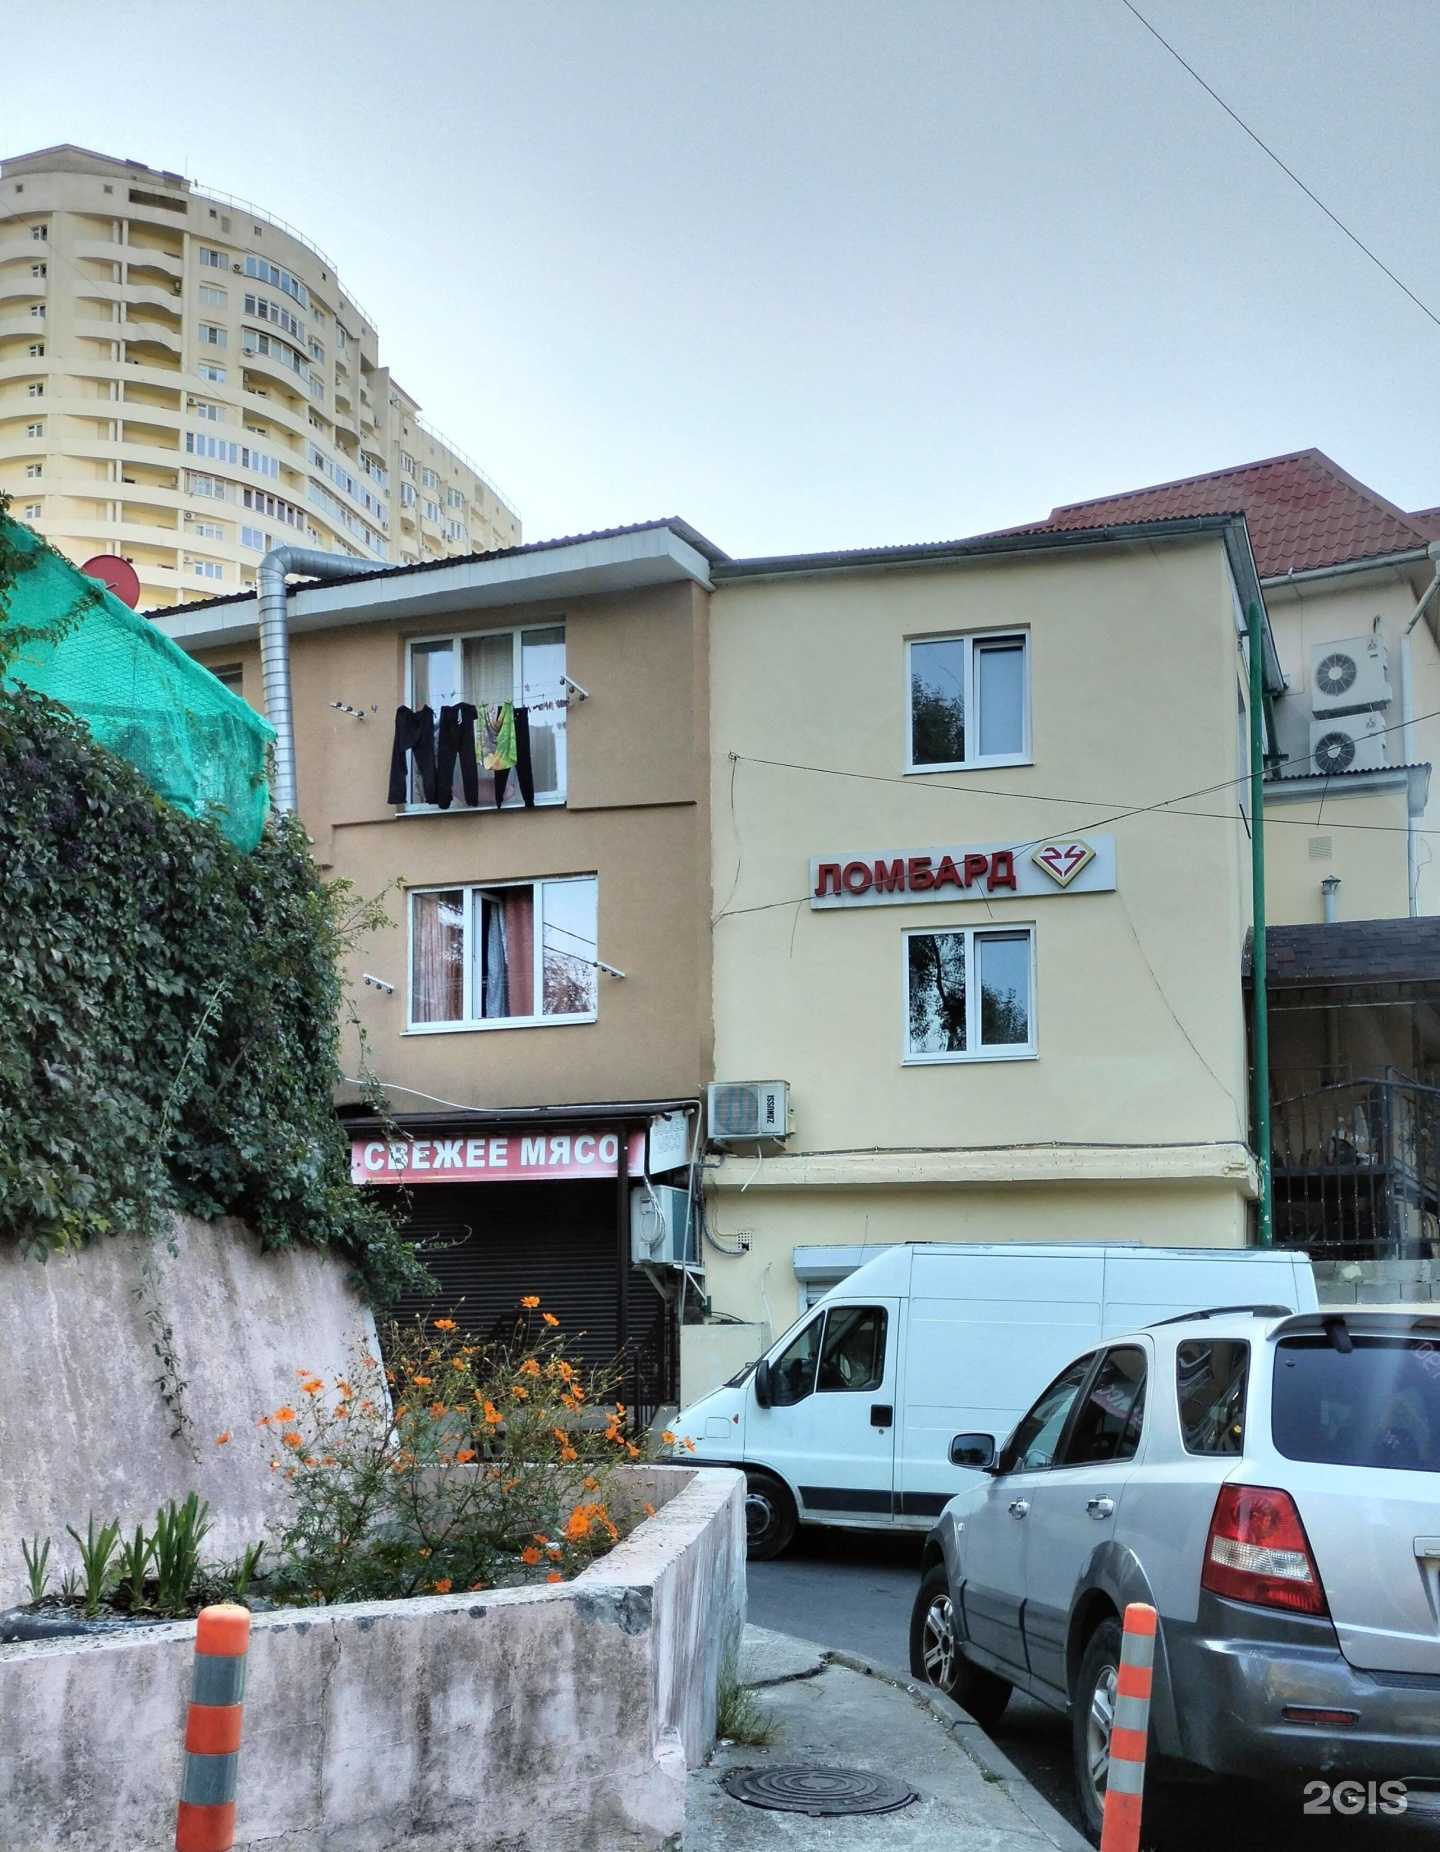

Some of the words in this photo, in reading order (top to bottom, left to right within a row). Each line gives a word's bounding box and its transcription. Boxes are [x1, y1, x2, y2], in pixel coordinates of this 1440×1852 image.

[815, 851, 1017, 897] ЛОМБАРД
[766, 1095, 775, 1124] ZANUSSI
[363, 1138, 509, 1171] СВЕЖЕЕ
[520, 1134, 618, 1166] МЯСО
